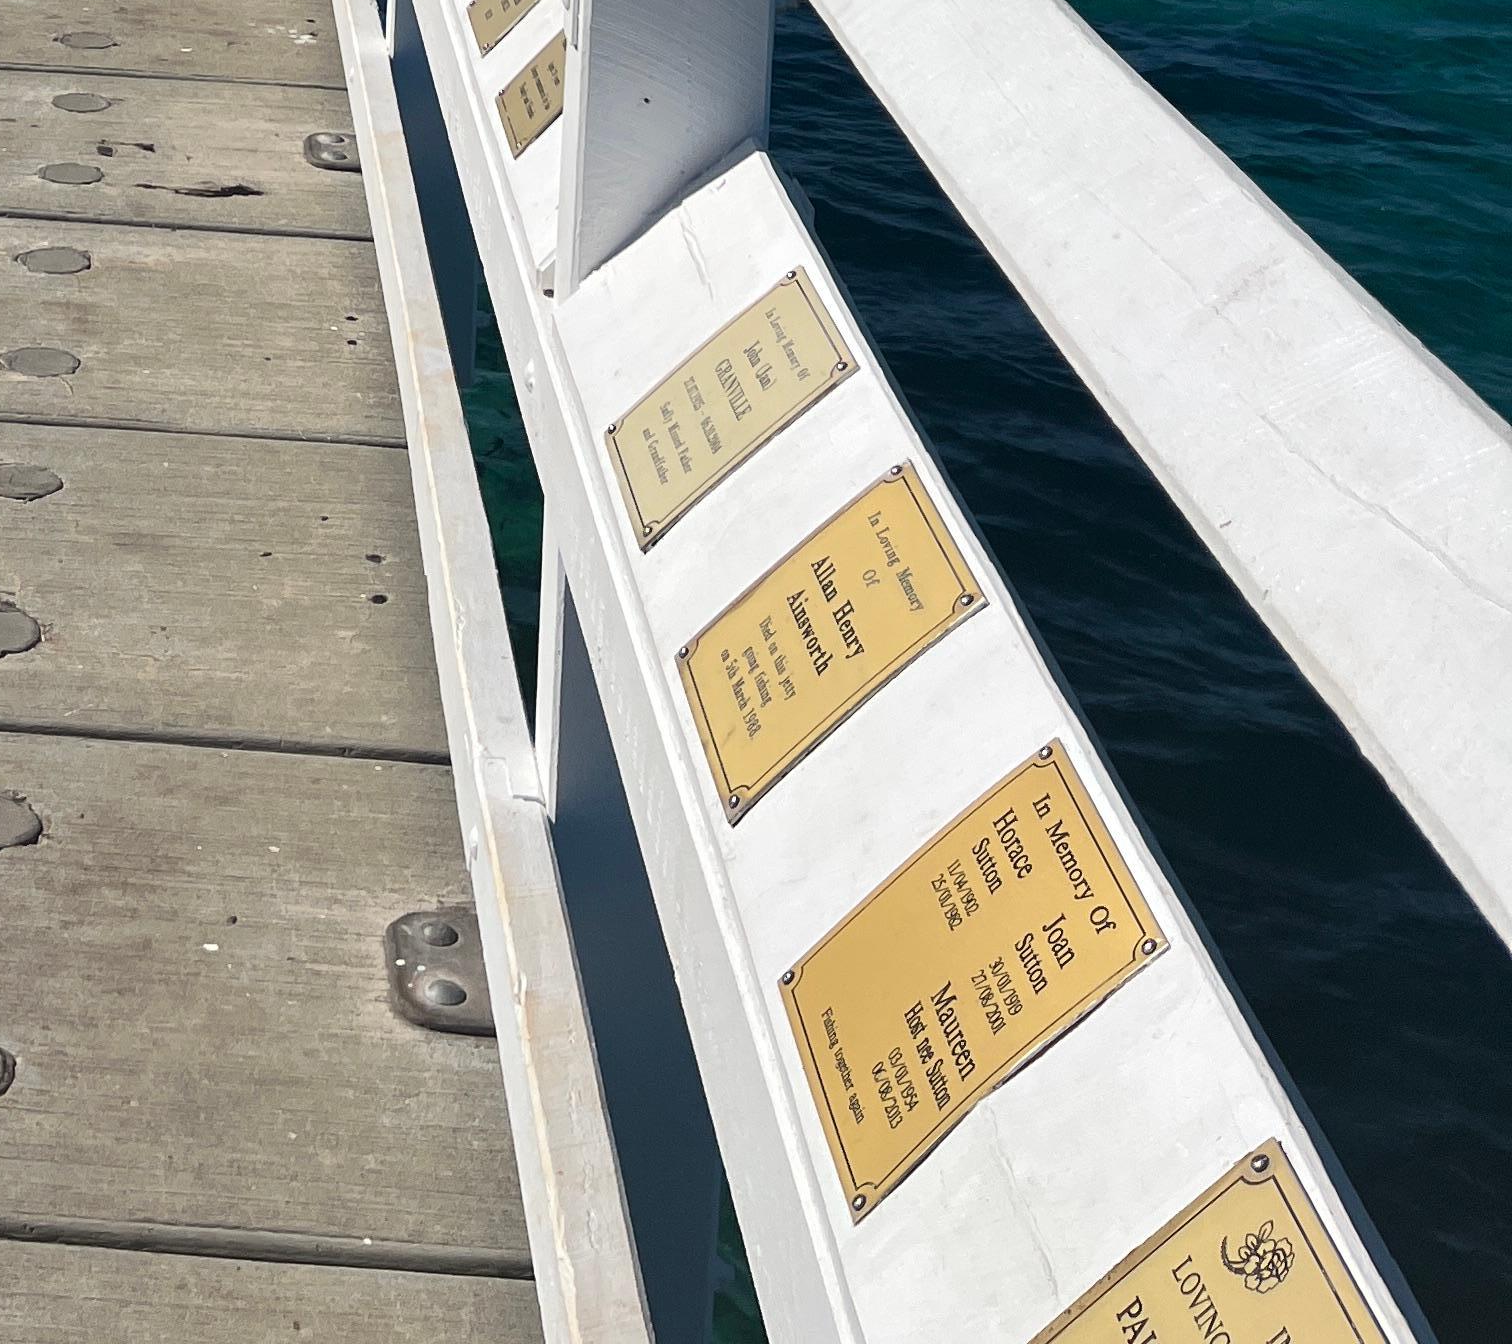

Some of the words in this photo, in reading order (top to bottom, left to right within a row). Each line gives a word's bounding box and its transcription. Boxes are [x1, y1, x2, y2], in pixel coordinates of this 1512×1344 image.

[764, 307, 777, 320] In
[768, 315, 787, 344] Loving
[742, 339, 763, 368] John
[754, 362, 777, 393] (Jan)
[781, 338, 801, 370] Memory
[796, 367, 811, 382] Of
[714, 357, 752, 422] GRANVILLE
[867, 509, 882, 528] In
[874, 525, 901, 568] Loving
[861, 568, 881, 588] Of
[895, 565, 924, 612] Memory
[758, 615, 777, 642] Died
[786, 589, 834, 677] Ainsworth
[810, 555, 838, 603] Allan
[831, 598, 865, 659] Henry
[720, 648, 730, 663] on
[724, 657, 740, 681] 5th
[767, 641, 778, 657] on
[773, 653, 787, 676] this
[731, 675, 751, 712] March
[741, 645, 760, 675] going
[753, 670, 772, 708] fishing
[777, 674, 797, 701] jetty
[971, 837, 1003, 895] Sutton
[991, 806, 1033, 879] Horace
[1031, 792, 1051, 820] In
[1044, 818, 1095, 900] Memory
[1089, 905, 1117, 935] Of
[930, 872, 963, 932] 25/01/1982
[946, 858, 980, 917] 11/04/1902
[1014, 932, 1048, 995] Sutton
[1041, 912, 1075, 970] Joan
[970, 968, 1007, 1036] 27/08/2001
[988, 956, 1023, 1016] 30/01/1919
[903, 999, 928, 1040] Host
[929, 980, 976, 1082] Maureen
[820, 1006, 839, 1050] Fishing
[833, 1046, 855, 1092] together
[848, 1092, 865, 1125] again
[915, 1036, 935, 1065] nee
[887, 1046, 920, 1113] 03/01/1954
[925, 1057, 951, 1111] Sutton
